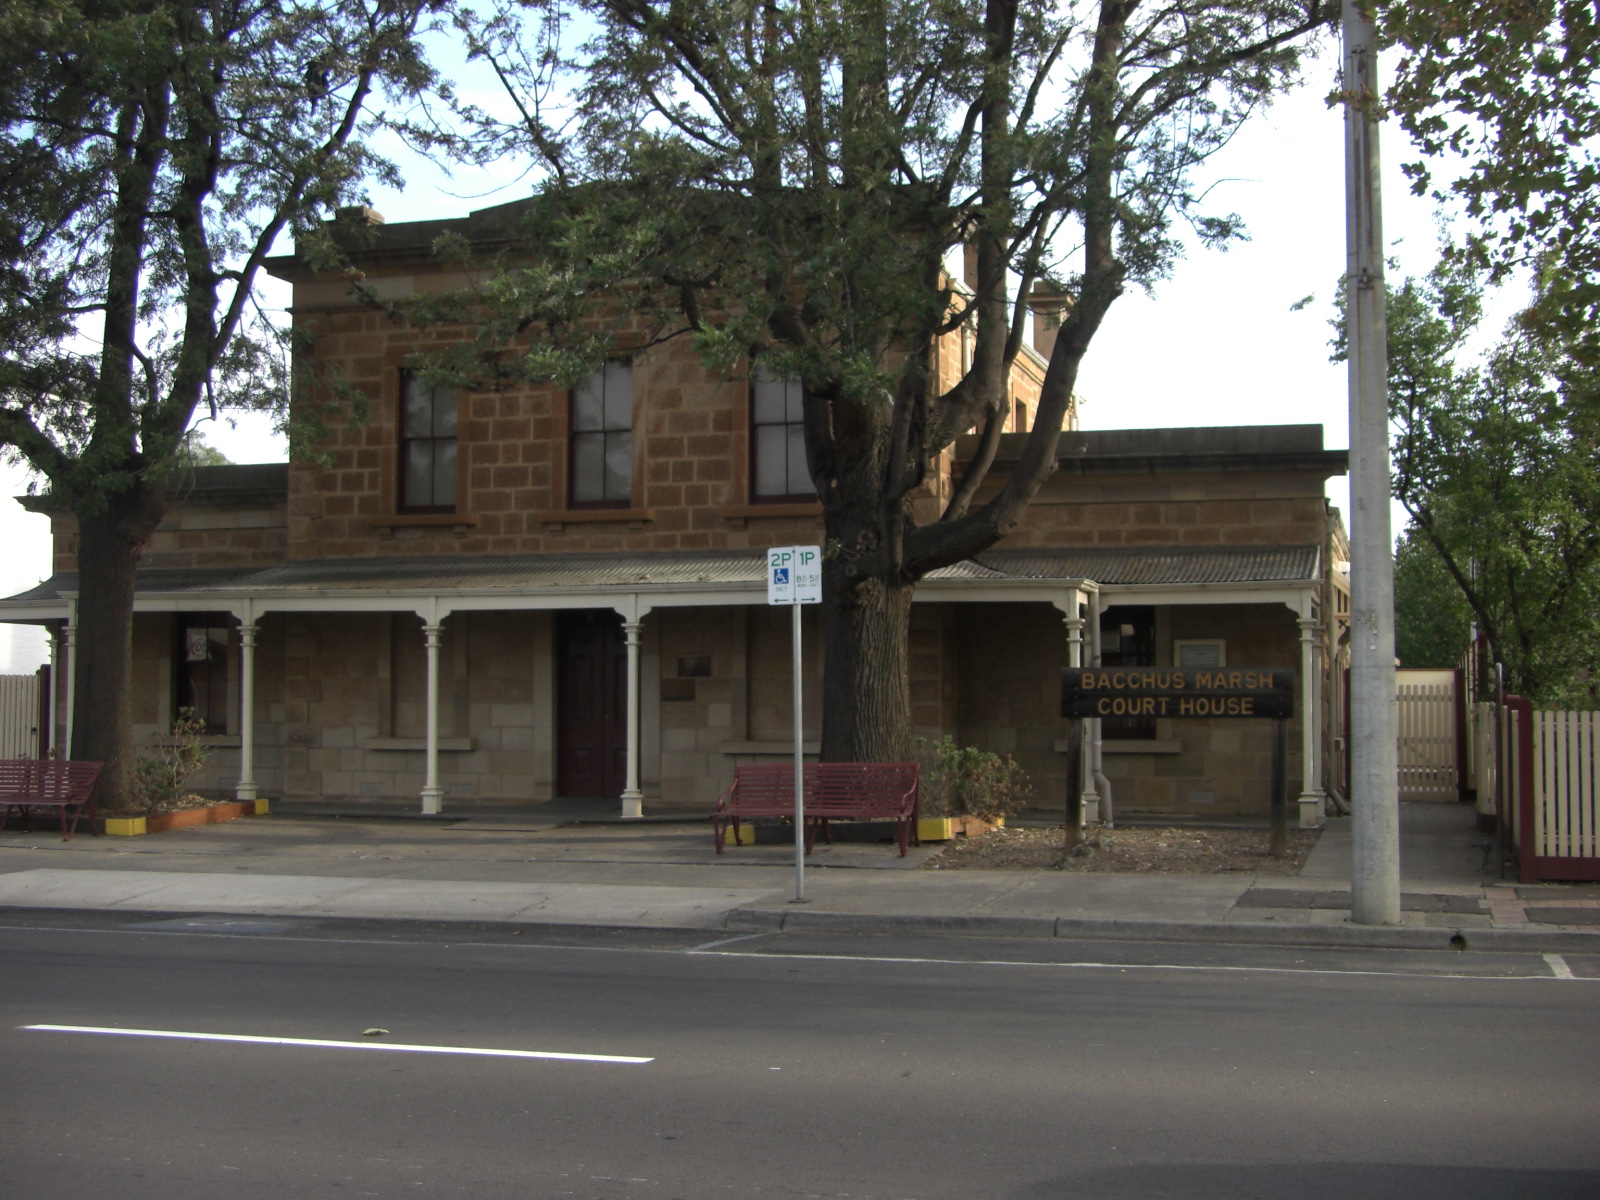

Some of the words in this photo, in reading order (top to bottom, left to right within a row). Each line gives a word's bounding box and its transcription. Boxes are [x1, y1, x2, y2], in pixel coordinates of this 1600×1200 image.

[771, 552, 792, 566] 2P
[800, 552, 815, 566] 1P
[1081, 672, 1185, 689] BACCHUS
[1196, 672, 1274, 689] MARSH
[1098, 697, 1169, 715] COURT
[1180, 697, 1253, 715] HOUSE
